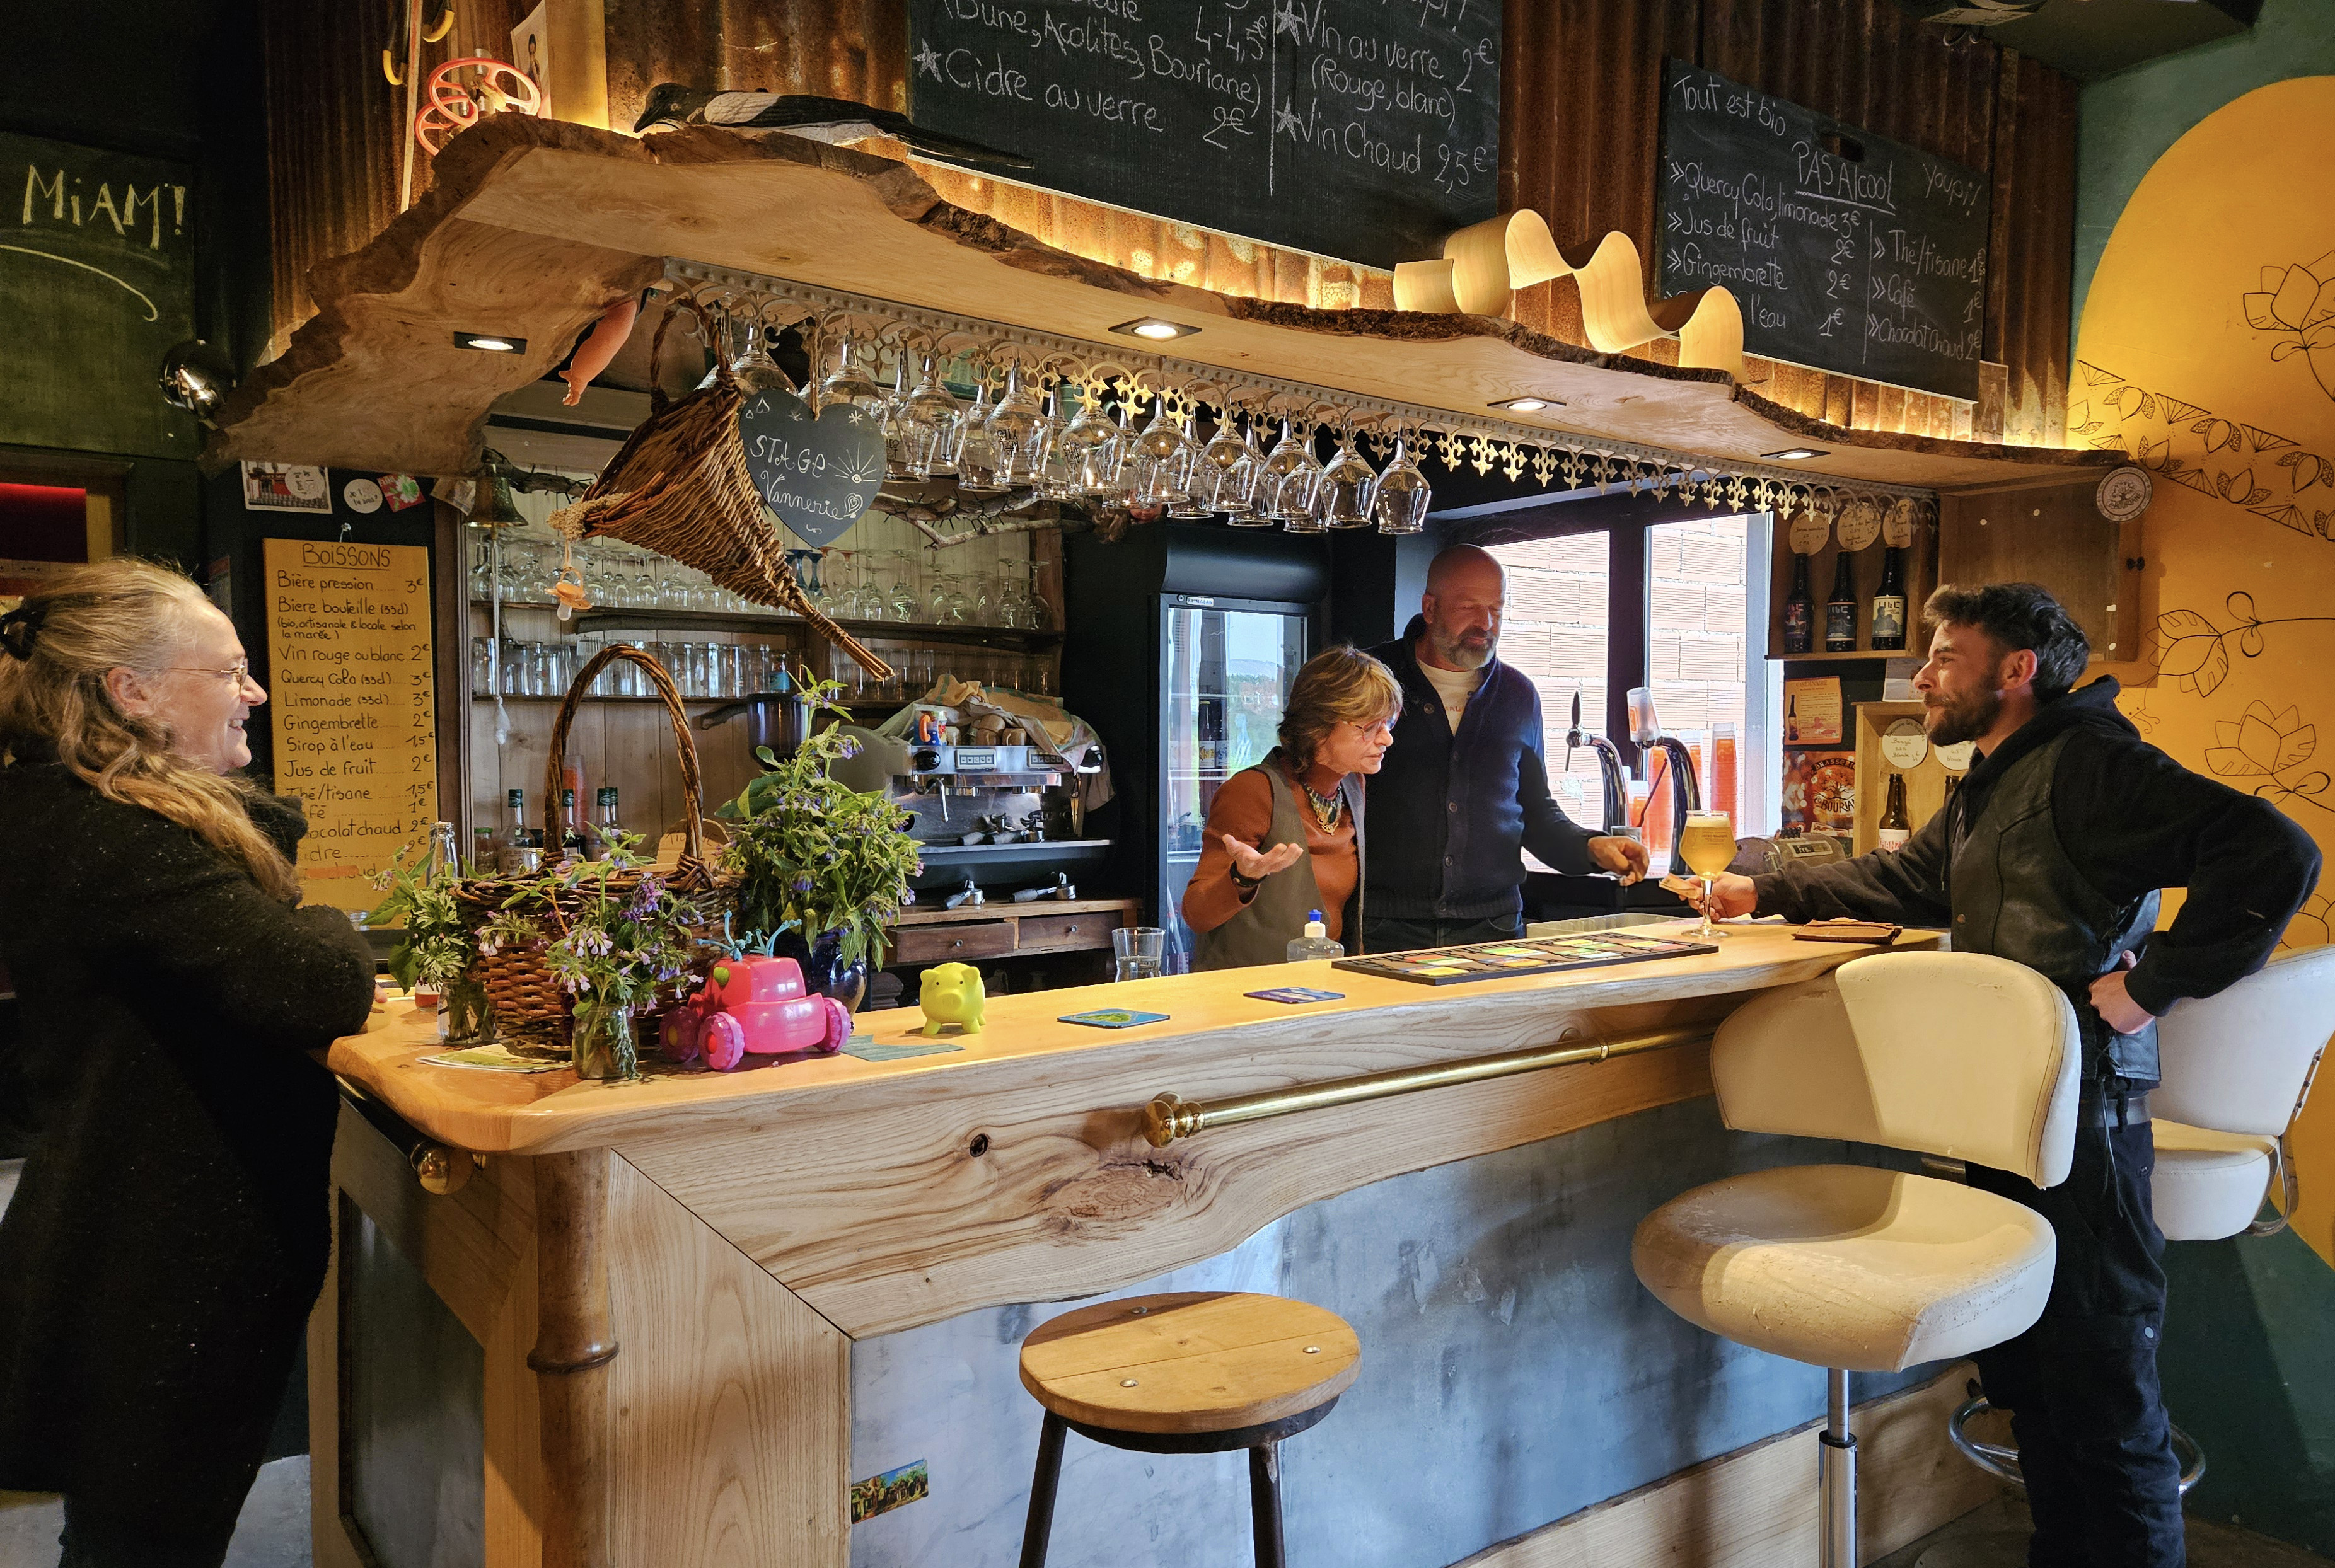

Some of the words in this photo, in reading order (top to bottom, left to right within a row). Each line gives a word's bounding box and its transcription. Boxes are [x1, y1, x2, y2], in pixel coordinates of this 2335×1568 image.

[1301, 0, 1341, 54] Vin
[1348, 36, 1377, 61] au
[1386, 41, 1444, 79] verre
[946, 48, 1033, 101] Cidre
[1045, 84, 1079, 109] au
[1087, 90, 1164, 132] verre
[1202, 106, 1254, 149] 2€
[1673, 74, 1722, 112] Tout
[1725, 91, 1754, 118] est
[1758, 96, 1786, 137] bio
[1299, 97, 1338, 154] Vin
[1344, 120, 1421, 174] Chaud
[1792, 141, 1833, 193] PAS
[1681, 207, 1712, 235] Jus
[1716, 211, 1735, 239] de
[1741, 217, 1780, 251] fruit
[1830, 239, 1855, 265] 2€
[1683, 242, 1788, 291] Gingembrette
[1826, 270, 1851, 299] 2€
[1818, 308, 1845, 337] 1€
[278, 570, 315, 588] Bière
[320, 577, 374, 593] pression
[405, 578, 424, 593] 3€
[322, 597, 375, 615] bouteille
[282, 630, 291, 639] la
[350, 620, 358, 628] &
[359, 618, 385, 630] locale
[391, 620, 416, 631] selon
[278, 643, 307, 660] Vin
[312, 650, 351, 665] rouge
[354, 653, 369, 661] ou
[370, 644, 405, 662] blanc
[411, 643, 431, 661] 2€
[281, 669, 325, 688] Quercy
[328, 668, 356, 685] Cola
[410, 671, 431, 686] 3€
[284, 691, 352, 707] Limonade
[413, 690, 431, 706] 3€
[283, 712, 379, 734] Gingembrette
[413, 710, 432, 727] 2€
[287, 737, 325, 756] Sirop
[330, 737, 339, 751] à
[342, 735, 374, 751] l'eau
[284, 759, 313, 778] Jus
[320, 761, 336, 776] de
[411, 754, 432, 773] 2€
[310, 804, 327, 819] fé
[408, 798, 427, 814] 1€
[306, 818, 356, 840] ocolat
[357, 820, 402, 836] chaud
[410, 817, 429, 833] 2€
